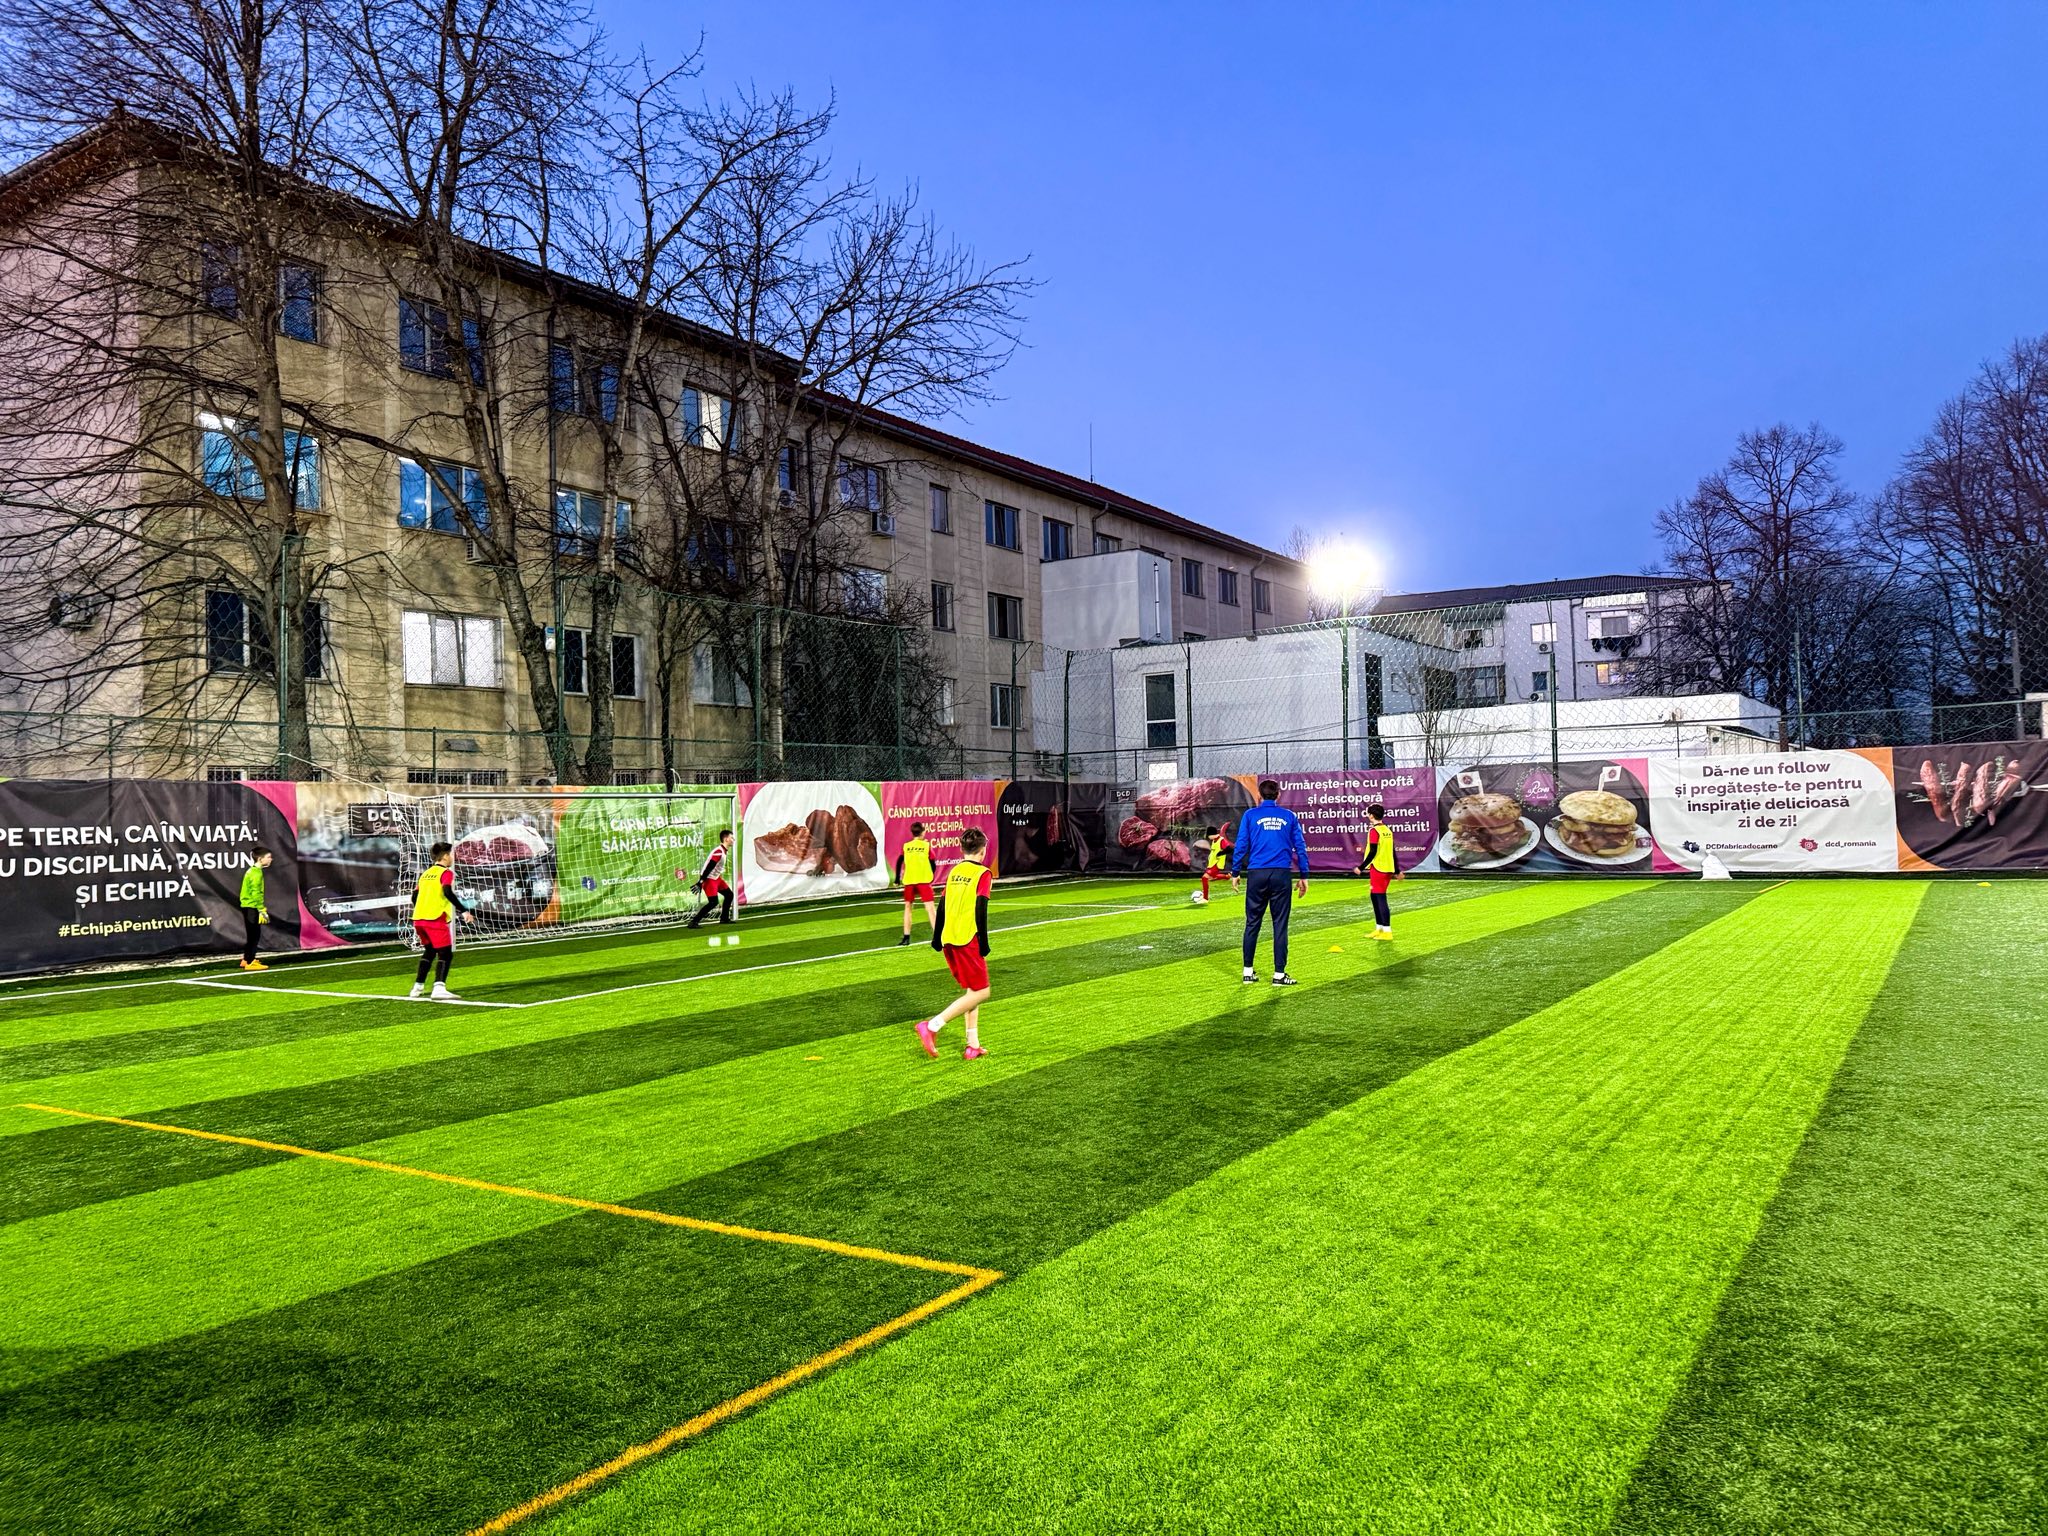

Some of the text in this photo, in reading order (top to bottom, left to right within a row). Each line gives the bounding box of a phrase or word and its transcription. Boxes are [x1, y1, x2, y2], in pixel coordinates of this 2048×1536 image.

[1702, 761, 1831, 777] Dă-ne un follow
[1279, 776, 1414, 792] Urmărește-ne cu poftă
[1674, 778, 1862, 798] și pregătește-te pentru
[1307, 792, 1383, 806] și descoperă
[1687, 796, 1850, 814] inspirație delicioasă
[914, 806, 954, 818] FOTBALUL
[963, 804, 992, 815] GUSTUL
[1318, 807, 1358, 818] fabricii
[922, 822, 936, 833] AC
[1308, 823, 1334, 834] care
[1738, 814, 1797, 828] zi de zi!
[29, 825, 119, 847] TEREN,
[124, 825, 159, 843] CA
[160, 820, 186, 843] ÎN
[188, 820, 259, 847] VIAȚĂ:
[930, 836, 960, 849] CAMPIO
[1825, 840, 1877, 848] dcd_romania
[24, 848, 172, 877] DISCIPLINĂ,
[175, 851, 255, 870] PASIUN
[75, 876, 195, 909] ȘI ECHIPĂ
[58, 915, 213, 938] #EchipăPentruViitor
